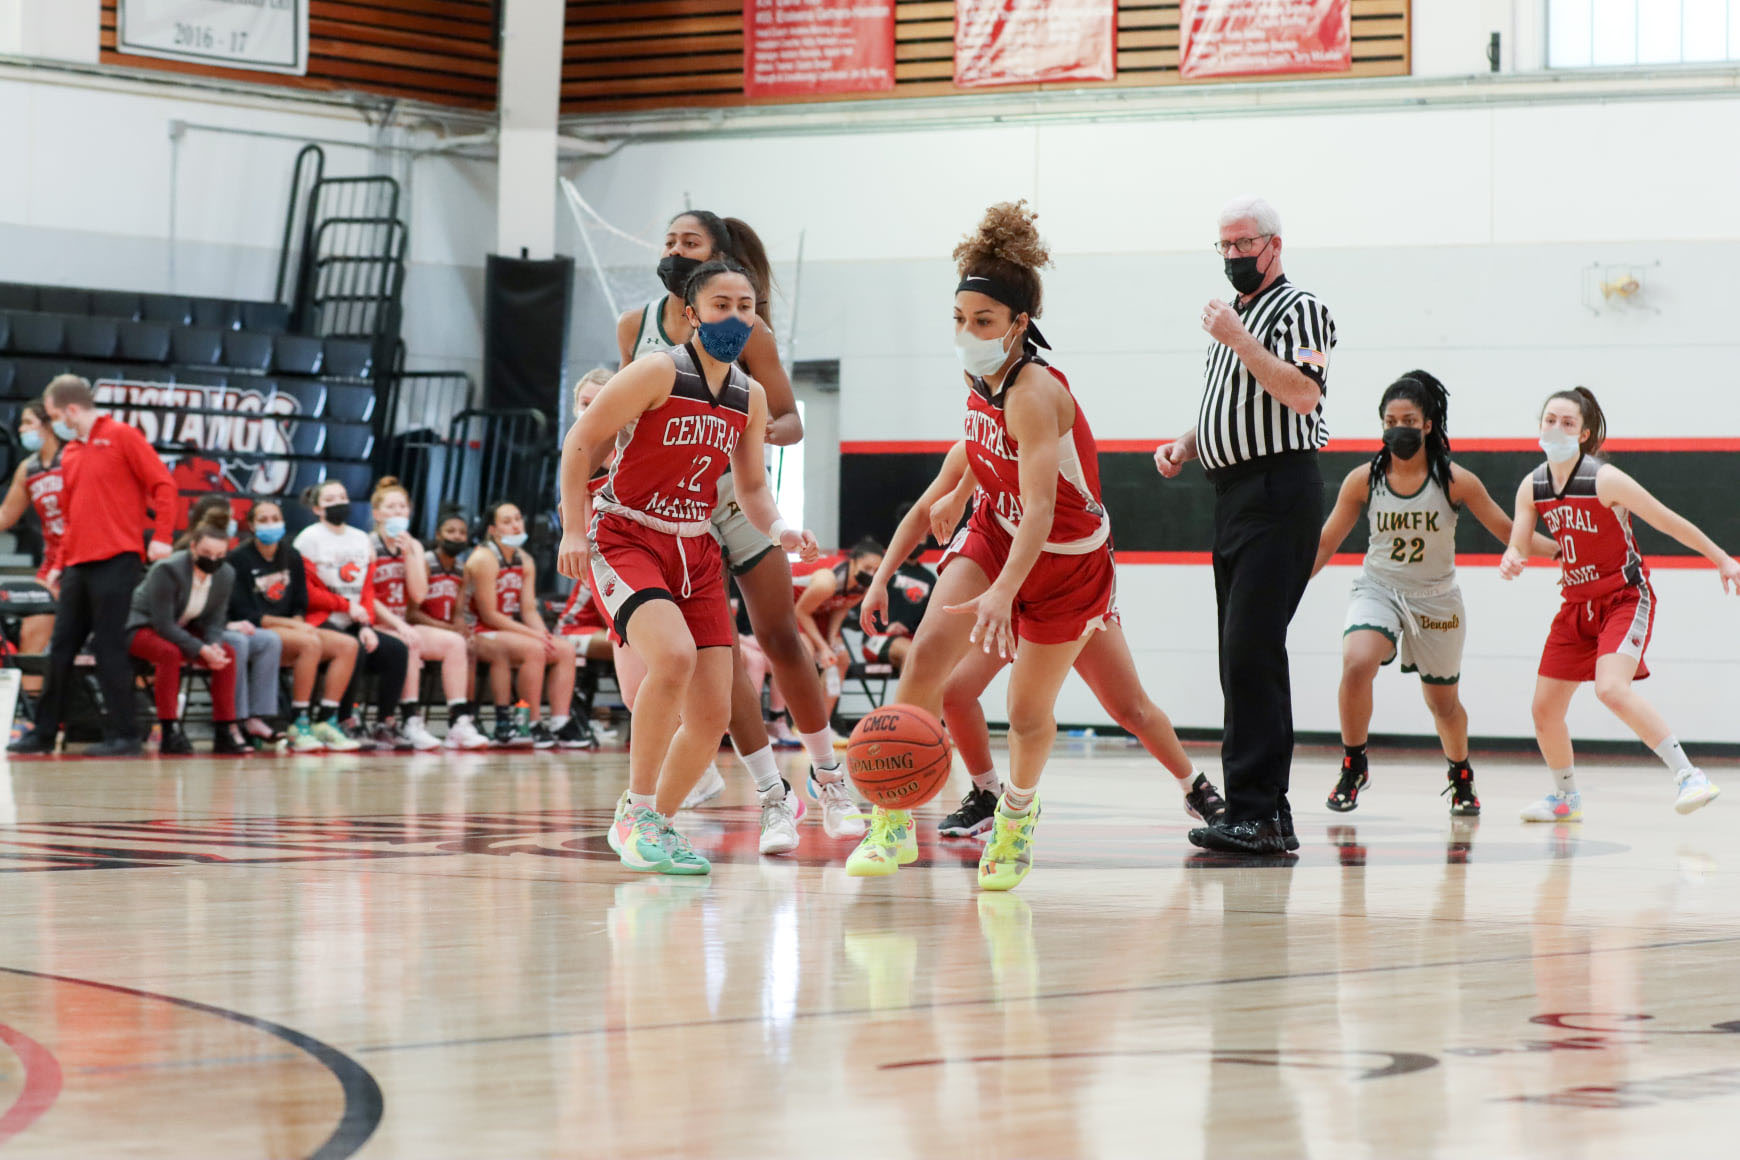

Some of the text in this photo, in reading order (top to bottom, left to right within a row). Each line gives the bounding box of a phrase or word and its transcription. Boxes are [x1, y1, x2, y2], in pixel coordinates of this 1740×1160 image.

[173, 22, 213, 49] 2016
[230, 31, 248, 53] 17
[645, 491, 709, 521] MAINE
[1376, 510, 1441, 533] UMFK
[1543, 505, 1599, 534] ENTRAL
[1390, 536, 1425, 564] 22
[1563, 564, 1600, 587] AINE
[1421, 613, 1460, 632] Bengals
[863, 715, 900, 734] CMCC
